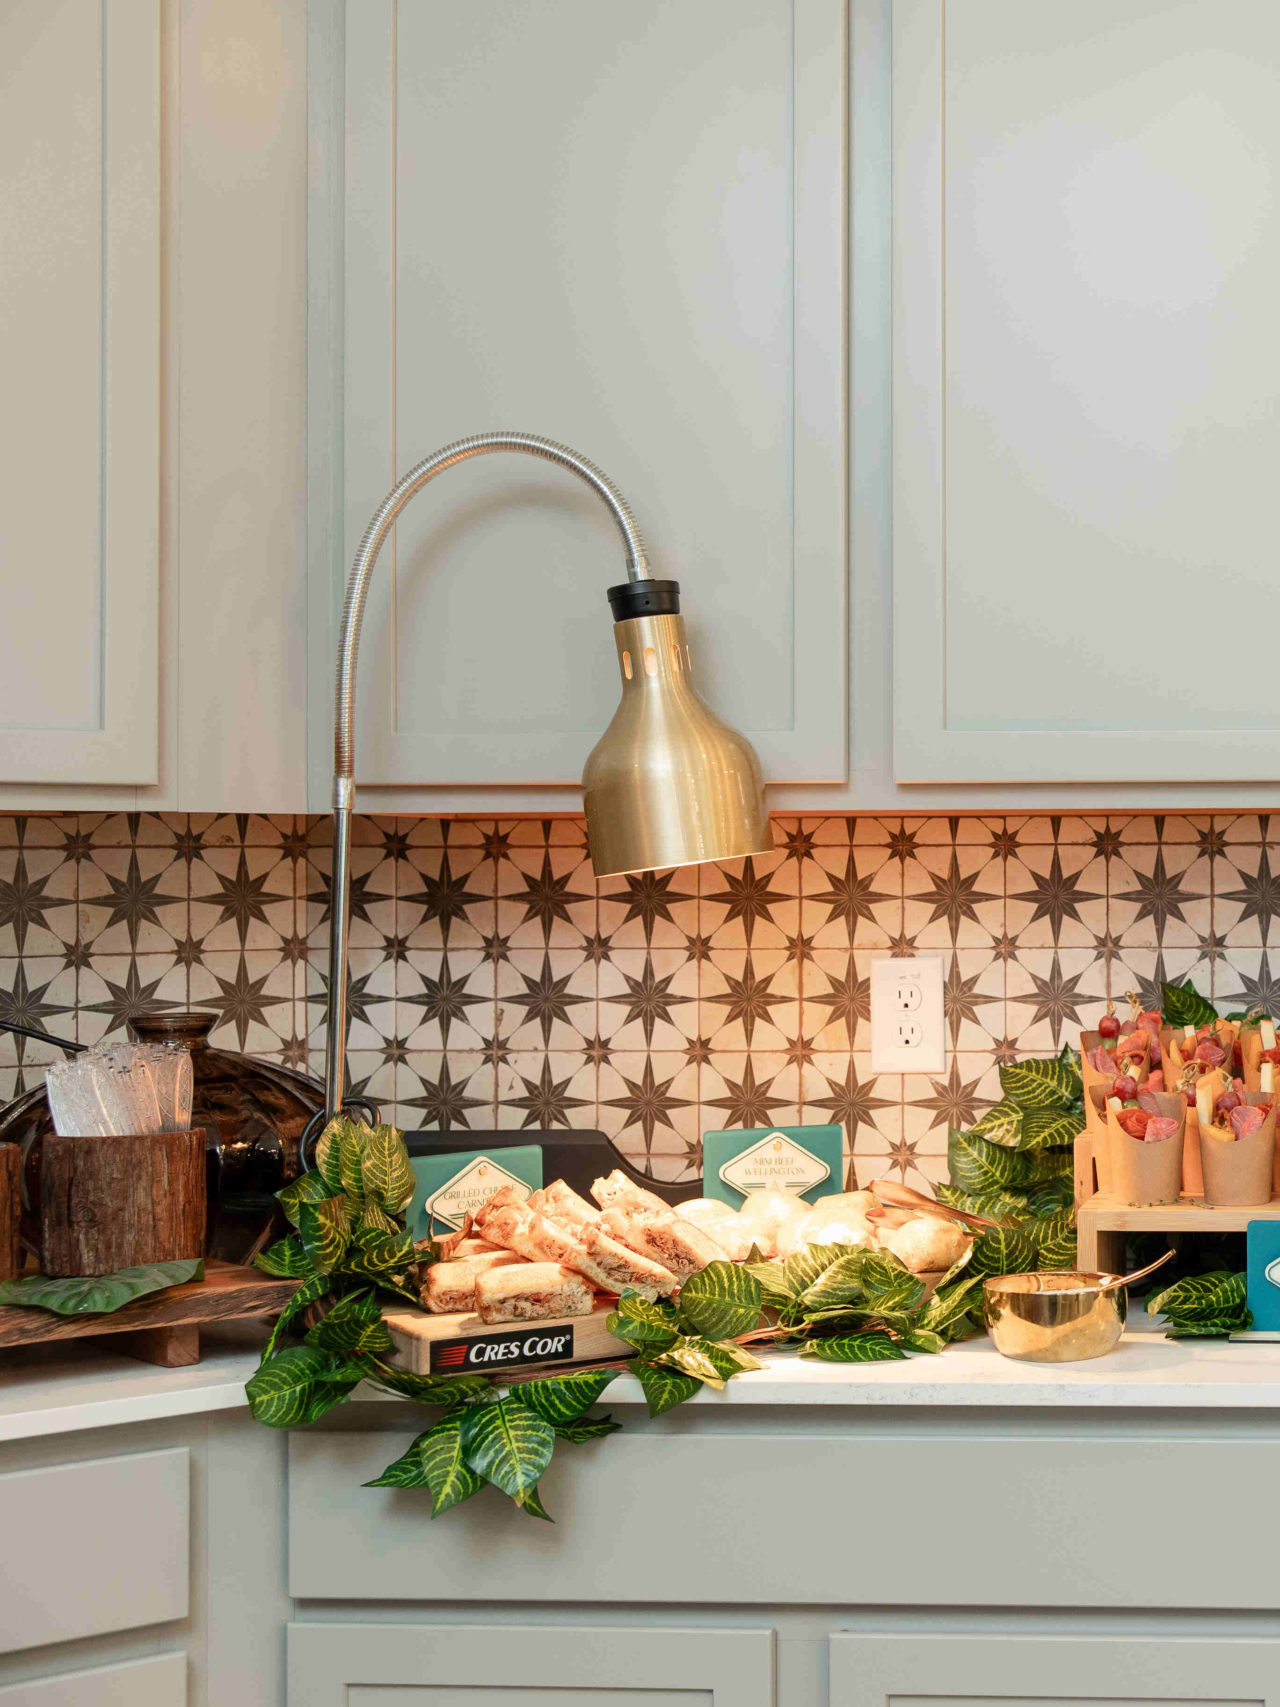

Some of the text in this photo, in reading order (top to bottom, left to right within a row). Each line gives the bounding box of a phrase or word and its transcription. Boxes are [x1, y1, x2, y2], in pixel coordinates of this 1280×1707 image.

[744, 1167, 805, 1176] WELLINGTON
[443, 1187, 480, 1201] GRILLED
[469, 1341, 521, 1363] CRES
